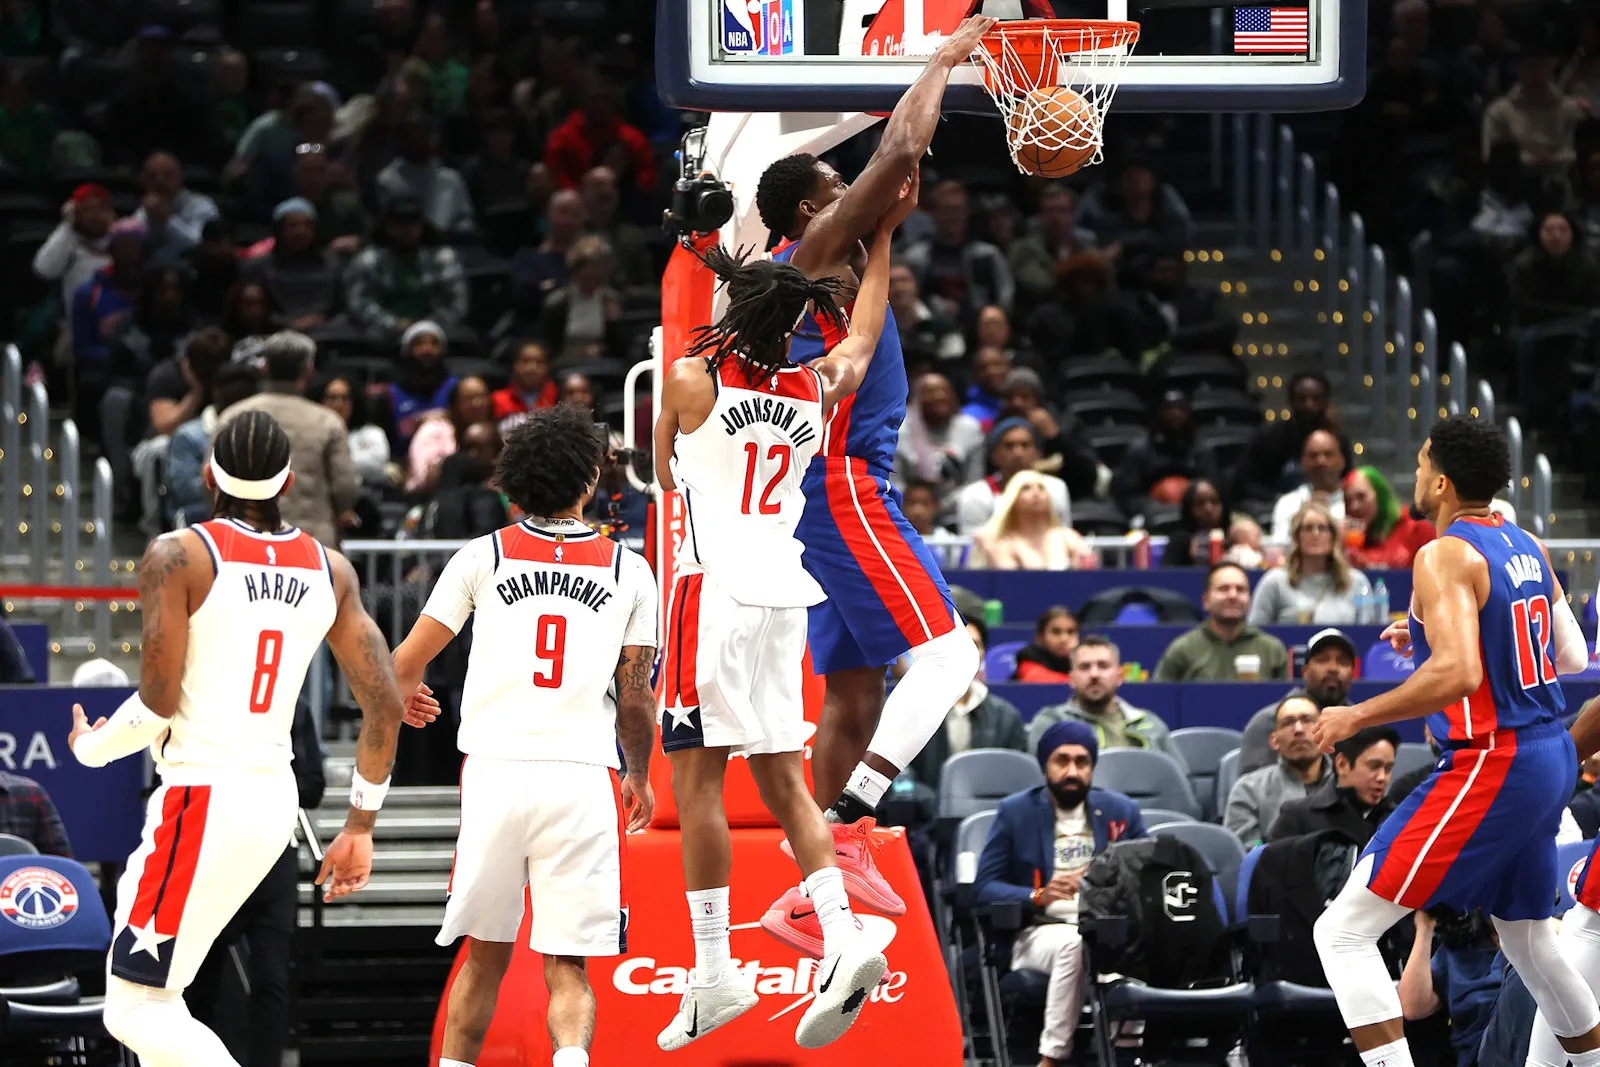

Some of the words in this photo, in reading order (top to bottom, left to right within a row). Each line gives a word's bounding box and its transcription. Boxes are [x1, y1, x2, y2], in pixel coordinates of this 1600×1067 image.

[728, 32, 748, 47] NBA
[720, 397, 798, 436] JOHNSON
[789, 420, 816, 448] III
[741, 441, 791, 515] 12
[244, 572, 310, 608] HARDY
[496, 571, 613, 613] CHAMPAGNIE
[533, 614, 567, 689] 9
[1511, 594, 1557, 690] 12
[249, 629, 284, 713] 8
[612, 957, 812, 995] Catal
